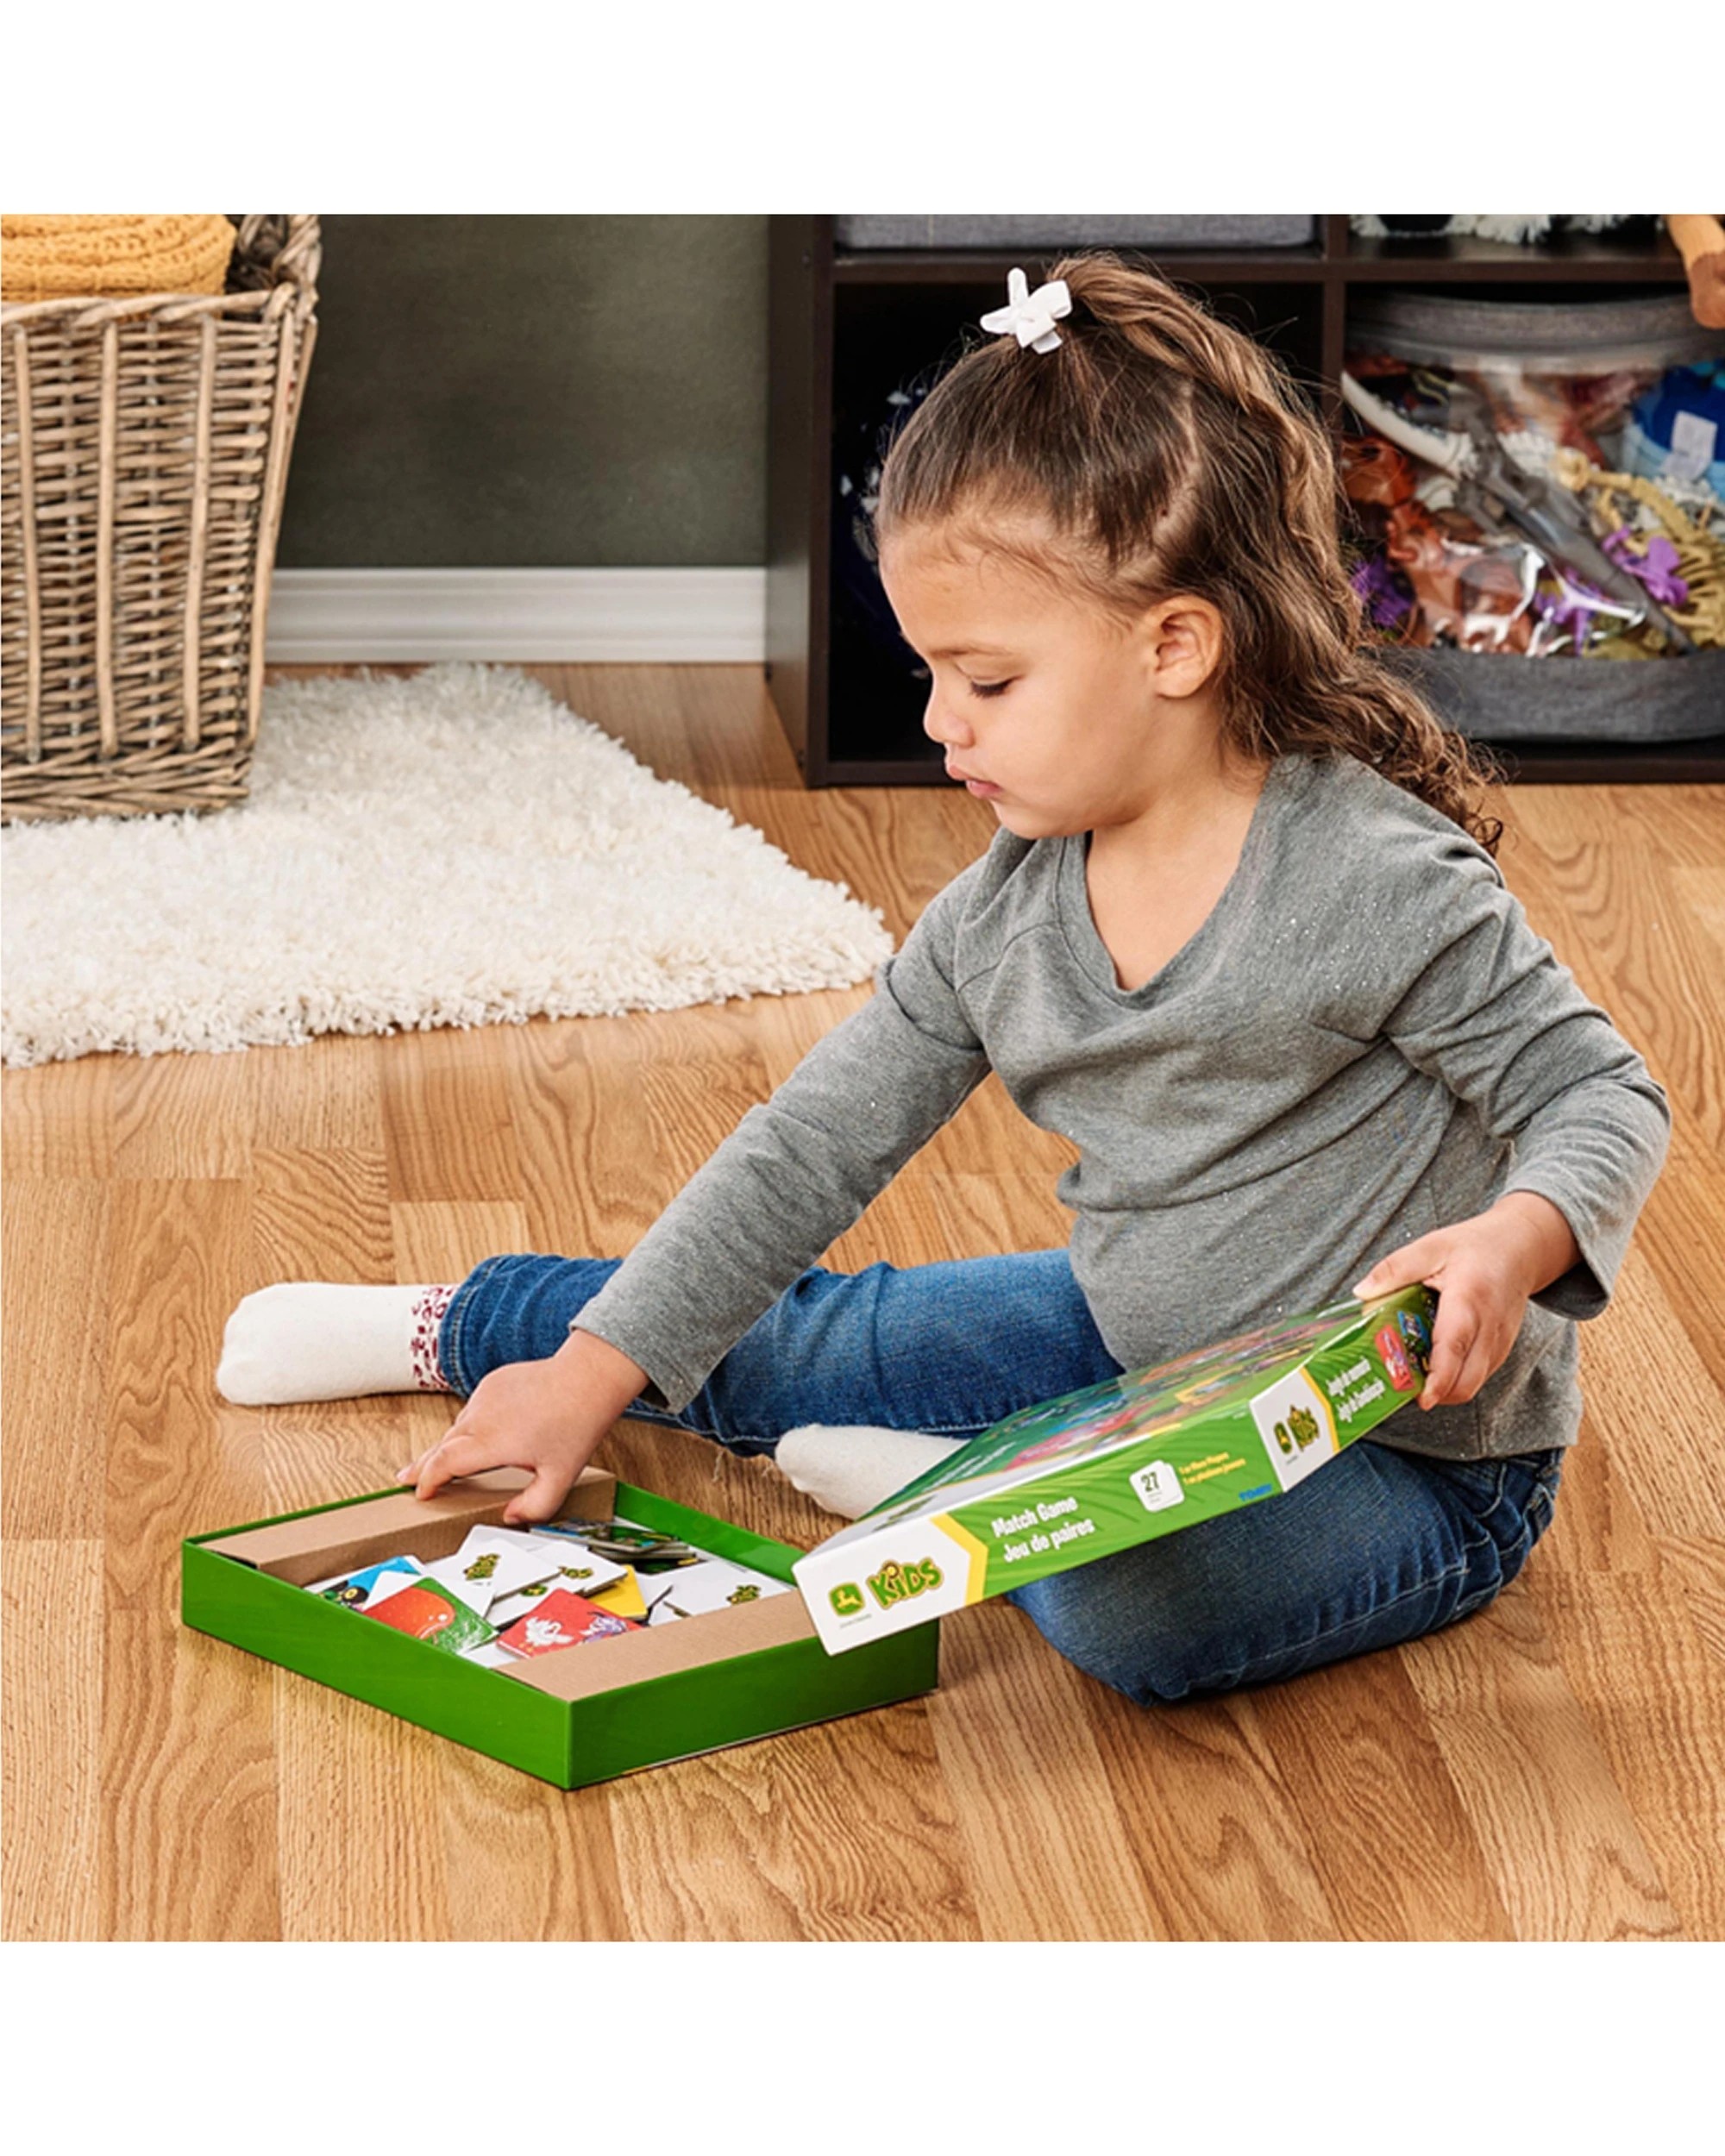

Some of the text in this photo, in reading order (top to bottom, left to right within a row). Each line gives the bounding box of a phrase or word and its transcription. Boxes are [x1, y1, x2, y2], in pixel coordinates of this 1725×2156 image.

[1141, 1471, 1160, 1492] 27
[991, 1496, 1078, 1539] Match Game
[1003, 1519, 1095, 1563] Jeu de paires
